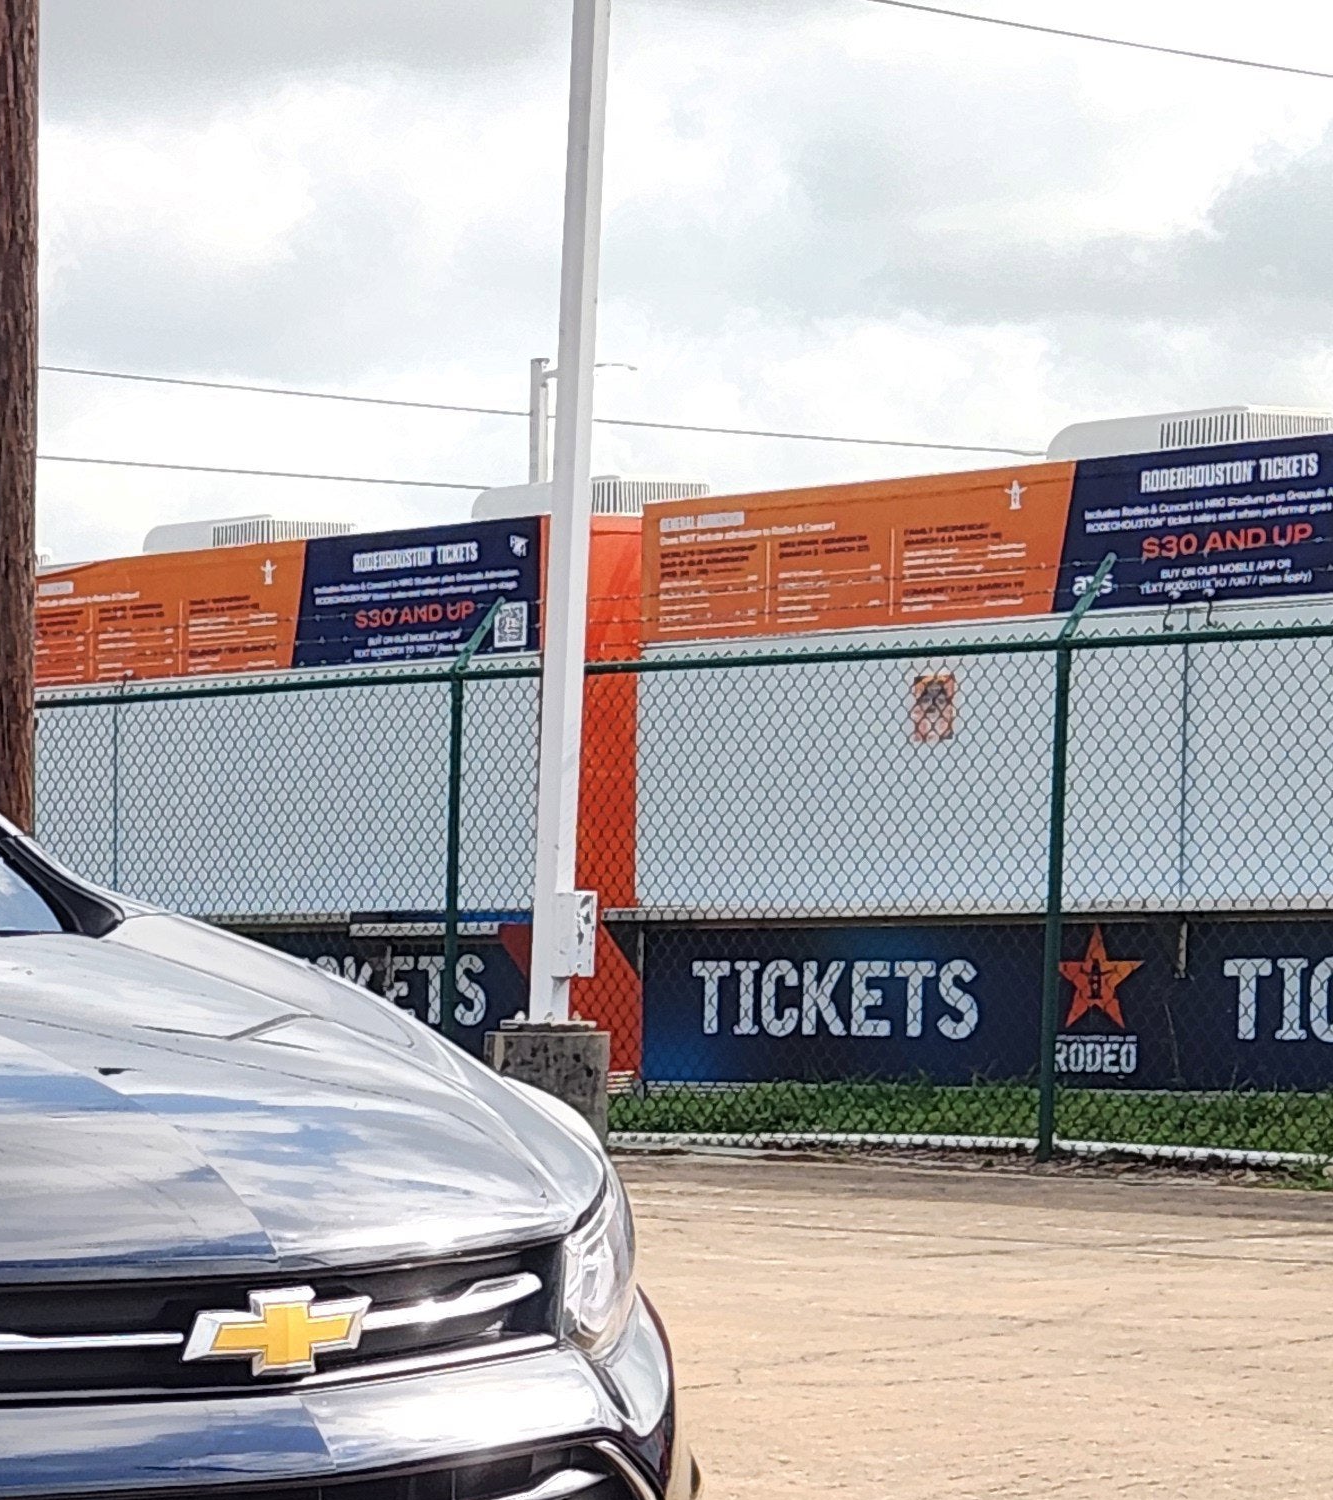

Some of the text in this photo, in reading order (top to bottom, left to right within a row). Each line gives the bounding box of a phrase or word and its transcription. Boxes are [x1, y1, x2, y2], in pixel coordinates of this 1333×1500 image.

[1259, 452, 1319, 481] TICKETS
[1203, 526, 1266, 553] AND
[1273, 522, 1313, 548] UP
[399, 602, 443, 625] AND
[446, 600, 475, 621] UP
[692, 959, 978, 1039] TICKETS
[1054, 1042, 1137, 1073] RODEO
